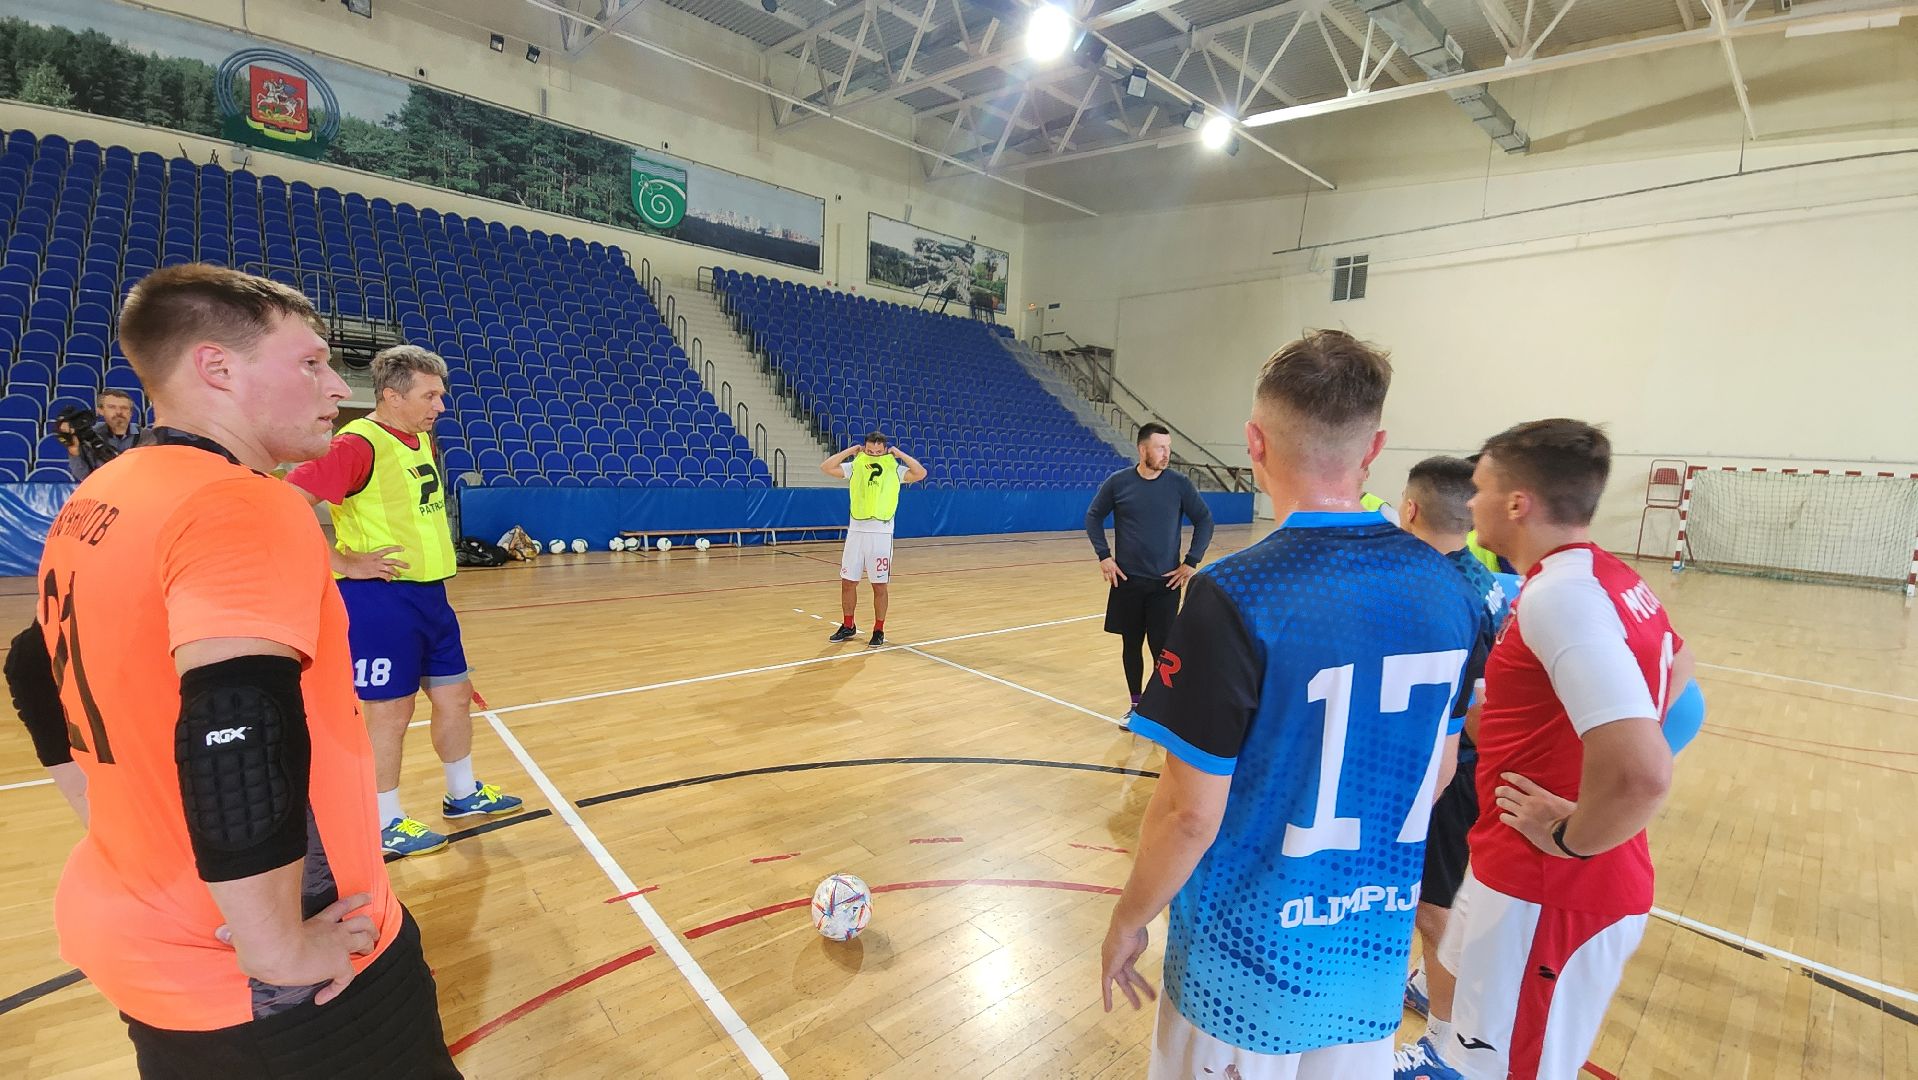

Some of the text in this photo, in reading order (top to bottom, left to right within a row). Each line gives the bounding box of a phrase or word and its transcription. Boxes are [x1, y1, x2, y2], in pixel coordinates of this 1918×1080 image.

[876, 557, 889, 572] 29
[354, 657, 392, 688] 18
[205, 726, 247, 747] RGX
[1281, 649, 1469, 858] 17
